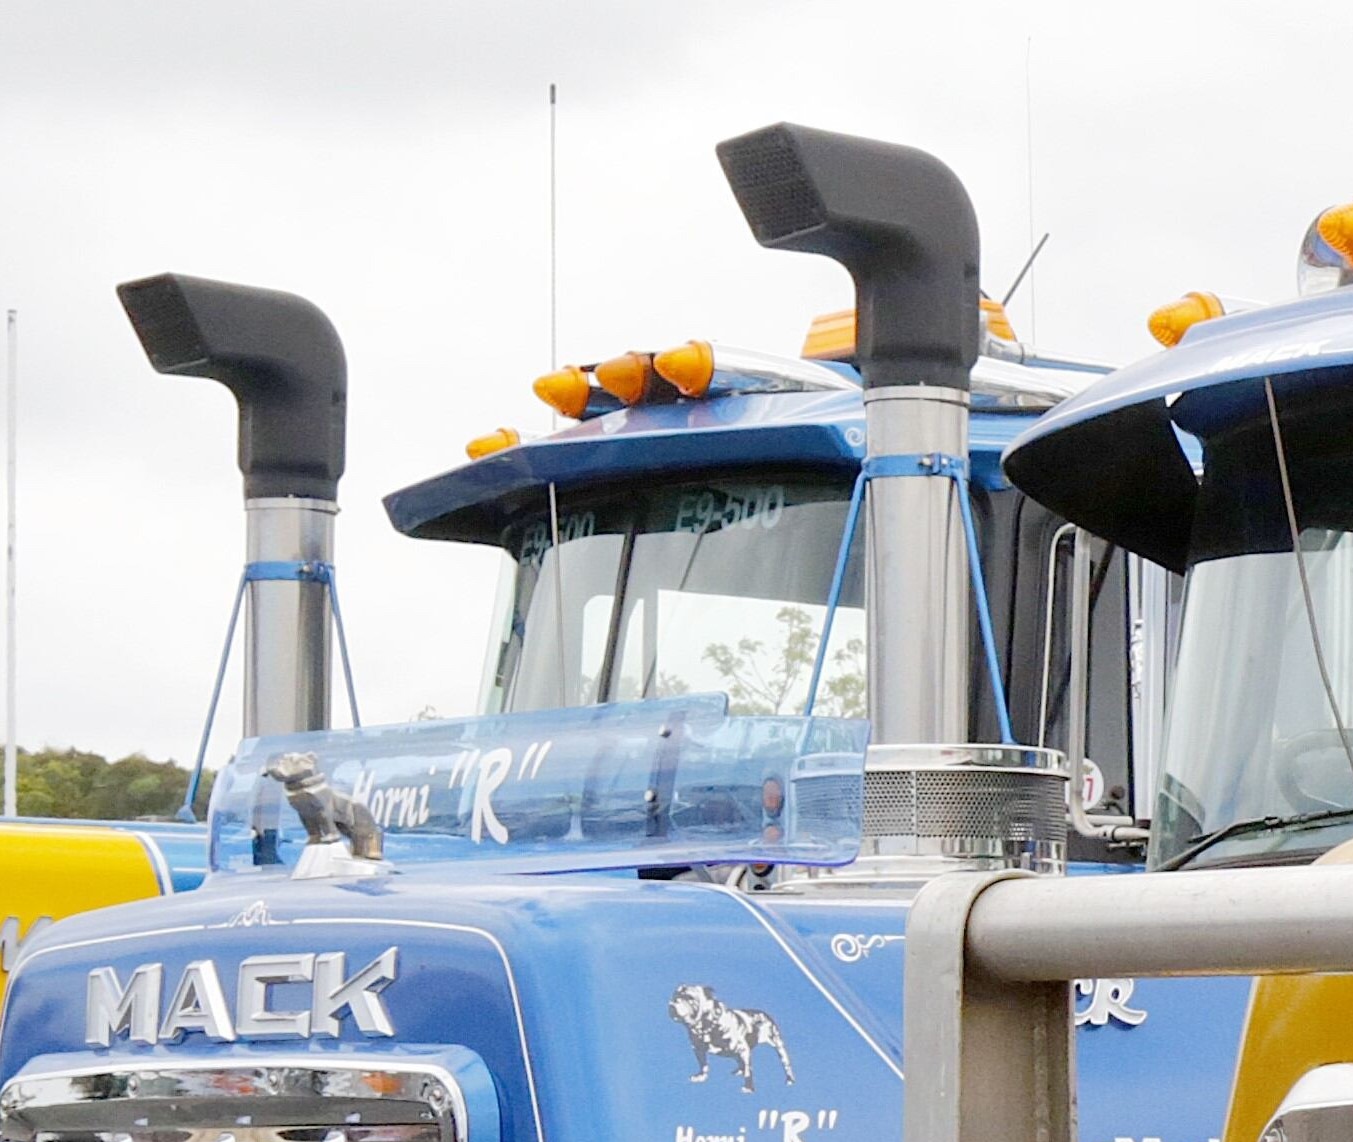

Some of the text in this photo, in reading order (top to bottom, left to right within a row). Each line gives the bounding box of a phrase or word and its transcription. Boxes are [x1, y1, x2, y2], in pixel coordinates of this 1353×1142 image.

[352, 766, 430, 827] Horni
[86, 946, 398, 1047] MACK
[1075, 979, 1147, 1026] ck
